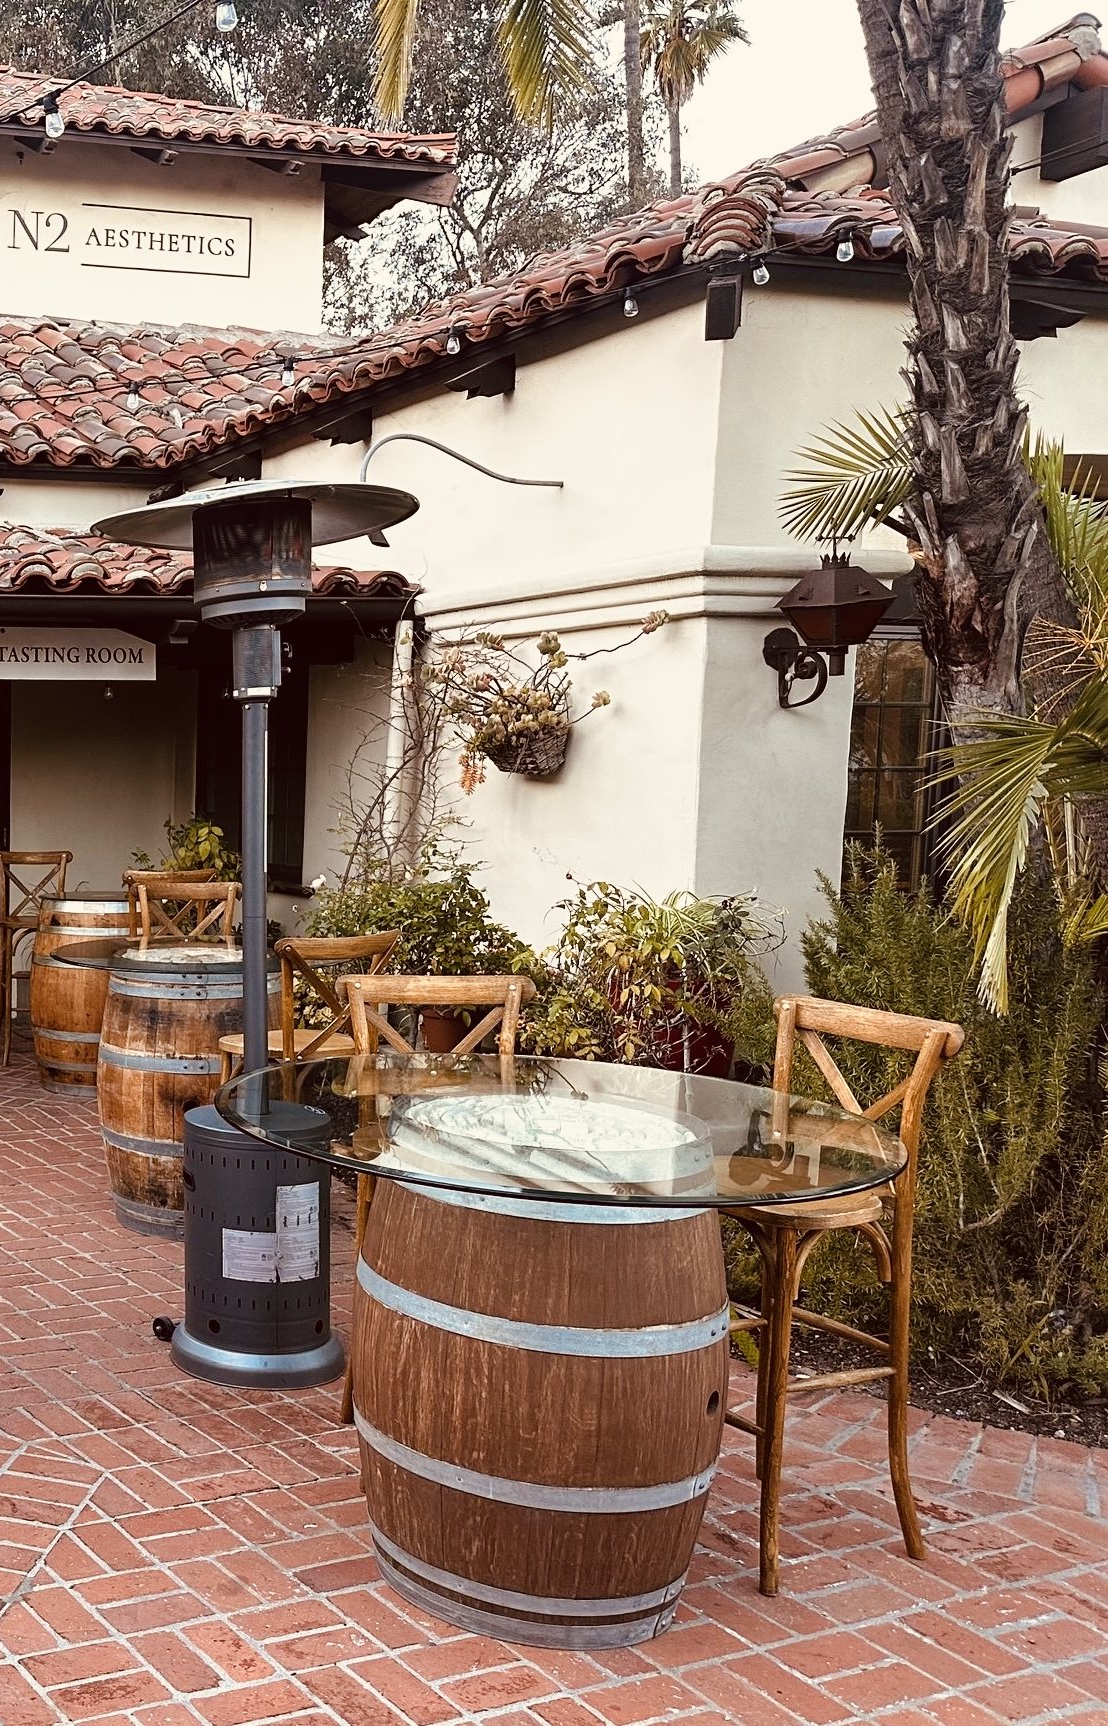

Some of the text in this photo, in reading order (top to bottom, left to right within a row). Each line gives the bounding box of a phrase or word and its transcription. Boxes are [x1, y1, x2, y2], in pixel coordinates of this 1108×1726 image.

[7, 209, 235, 257] N2 AESTHETICS
[85, 647, 144, 664] ROOM
